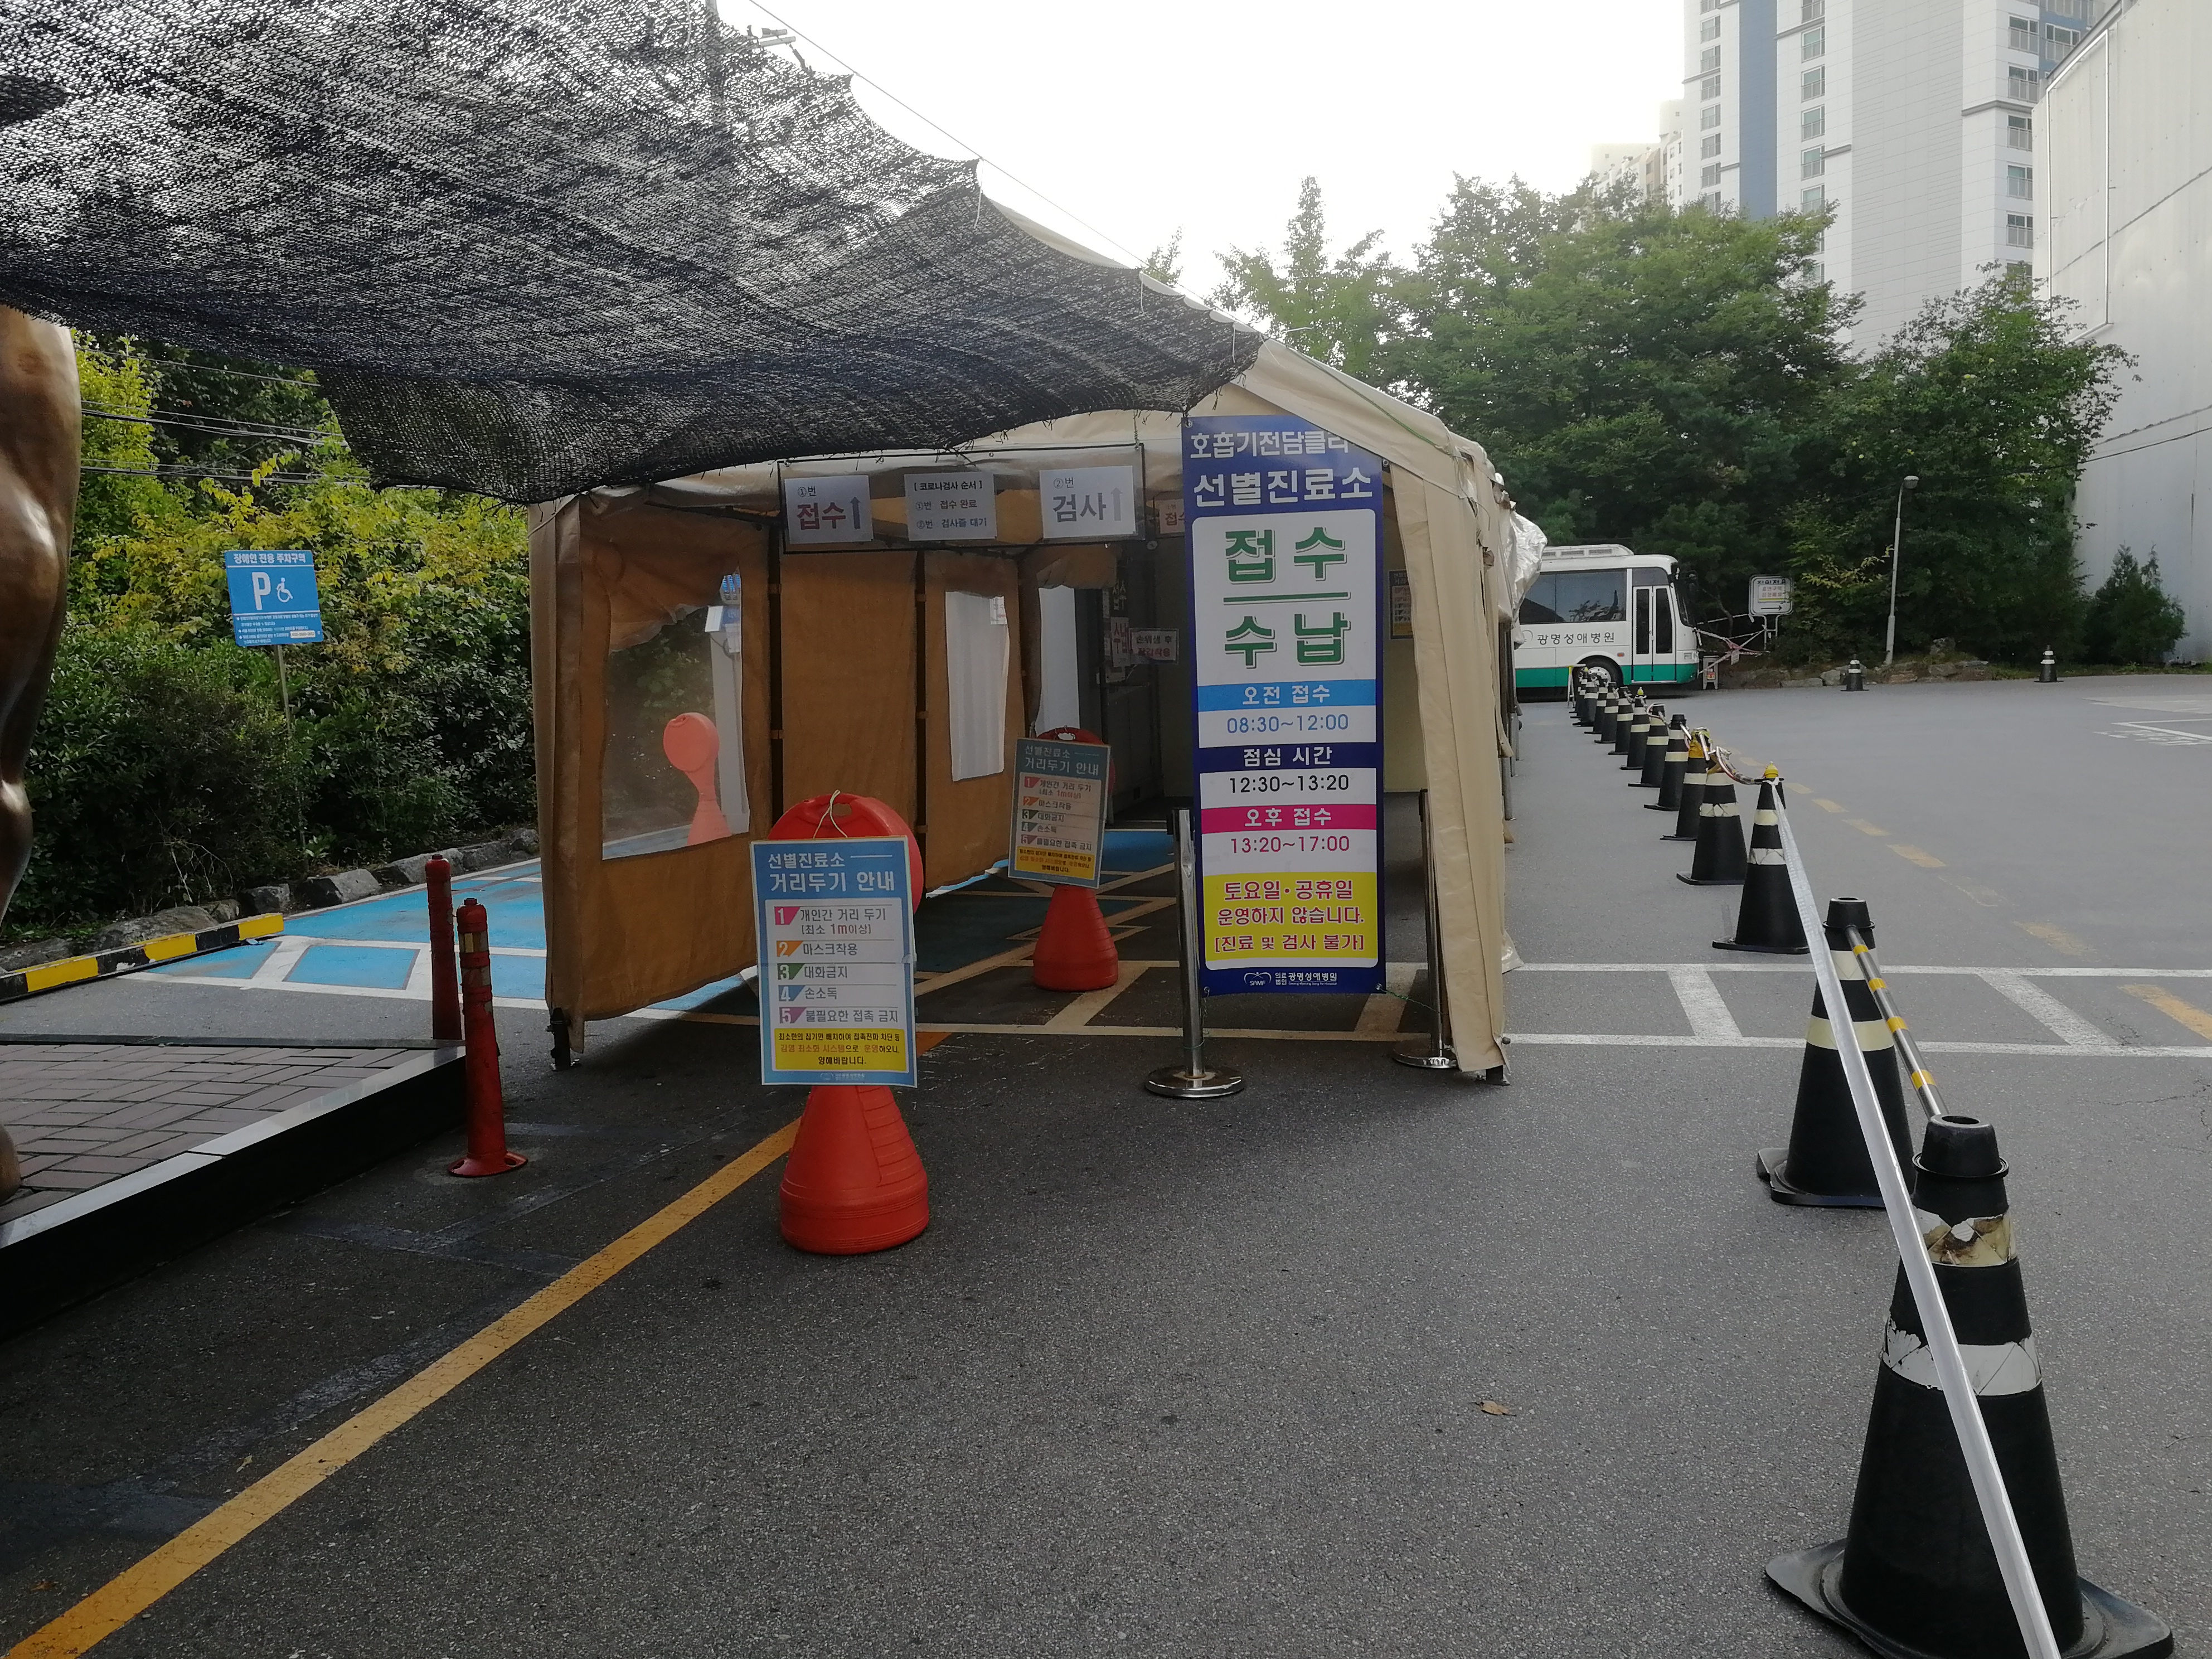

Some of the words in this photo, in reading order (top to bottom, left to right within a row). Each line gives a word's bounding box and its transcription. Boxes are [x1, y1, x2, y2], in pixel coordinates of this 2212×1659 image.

[1190, 430, 1349, 459] 호흡기전담클리
[920, 481, 958, 491] 코로나검사
[961, 481, 977, 489] 순서
[1194, 468, 1372, 508] 선별진료소
[940, 500, 957, 509] 접수
[960, 499, 977, 508] 완료
[1052, 492, 1107, 523] 검사
[797, 502, 846, 530] 접수
[970, 517, 987, 527] 대기
[233, 554, 257, 564] 장애인
[259, 553, 275, 564] 전용
[276, 553, 306, 564] 주차구역
[1225, 526, 1346, 584] 접수
[252, 571, 271, 610] P
[1224, 612, 1351, 669] 수납
[1537, 632, 1614, 645] 광명성애병원
[1242, 686, 1280, 705] 오전
[1292, 685, 1330, 704] 접수
[1226, 714, 1348, 734] 08:30~12:00
[1244, 748, 1281, 767] 점심
[1292, 746, 1332, 765] 시간
[1025, 757, 1069, 773] 거리두기
[1076, 762, 1099, 775] 안내
[1229, 774, 1349, 793] 12:30~13:20
[1025, 797, 1030, 806] 2
[1244, 808, 1282, 827] 오후
[1293, 808, 1332, 827] 접수
[1231, 836, 1350, 853] 13:20~17:00
[768, 852, 846, 869] 선별진료소
[770, 872, 846, 892] 거리두기
[856, 871, 894, 891] 안내
[778, 908, 785, 924] 1
[800, 909, 832, 921] 개인간
[838, 909, 859, 921] 거리
[864, 908, 886, 921] 두기
[1217, 907, 1284, 926] 운영하지
[1292, 906, 1364, 924] 않습니다.
[779, 942, 788, 957] 2
[803, 943, 858, 956] 마스크착용
[1215, 935, 1254, 953] [진료
[1262, 937, 1274, 950] 및
[1282, 934, 1316, 950] 검사
[1323, 934, 1364, 951] 불가]
[780, 964, 789, 980] 3
[804, 966, 848, 978] 대화금지
[1288, 972, 1337, 981] 광명성애병원
[781, 986, 790, 1001] 4
[805, 987, 837, 1000] 손소독
[782, 1008, 791, 1023] 5
[806, 1010, 848, 1022] 불필요한
[853, 1010, 874, 1022] 접촉
[879, 1010, 898, 1022] 금지
[818, 1056, 866, 1065] 양해바랍니다.
